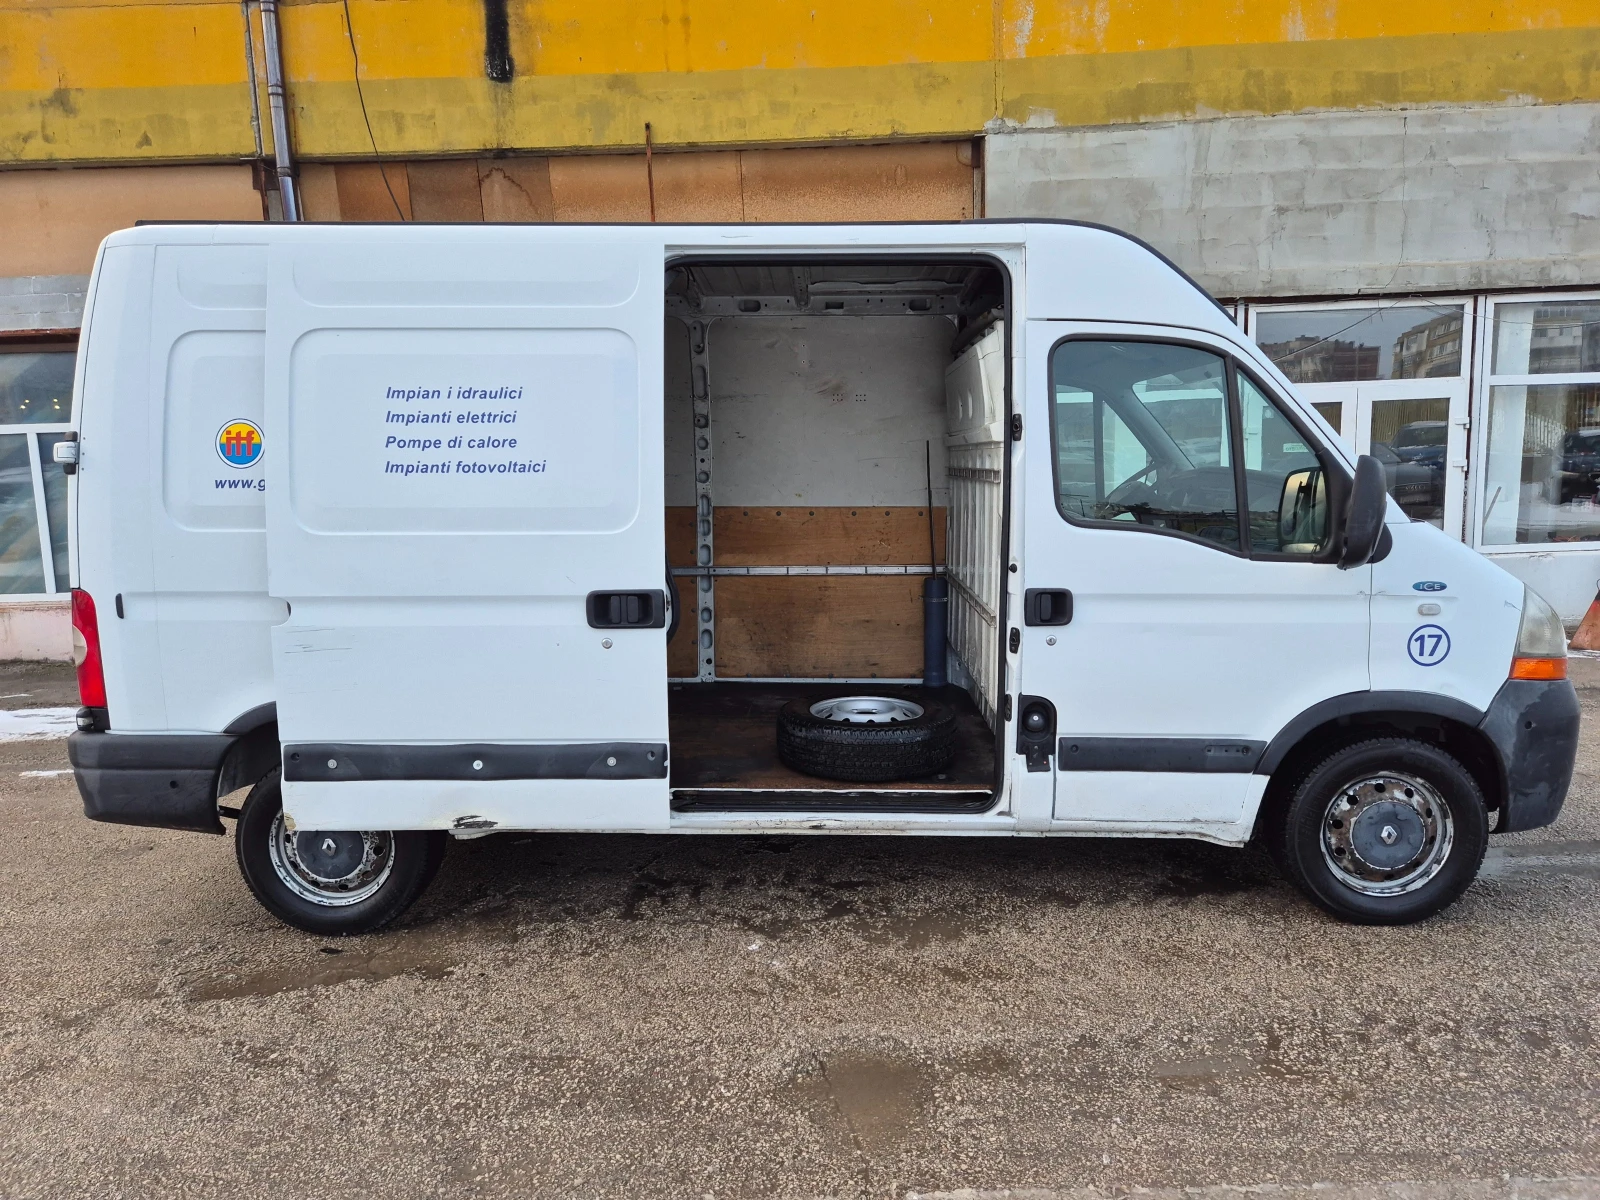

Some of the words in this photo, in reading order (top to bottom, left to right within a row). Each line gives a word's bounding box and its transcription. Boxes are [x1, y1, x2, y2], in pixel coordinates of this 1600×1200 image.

[457, 386, 523, 399] idraulici
[385, 410, 452, 426] Impianti
[456, 410, 517, 423] elettrici
[225, 430, 255, 456] itf
[385, 435, 442, 451] Pompe
[447, 435, 463, 449] di
[467, 435, 517, 449] calore
[385, 460, 452, 476] Impianti
[455, 459, 547, 474] fotovoltaici
[1419, 582, 1441, 591] ICE
[1414, 634, 1443, 657] 17
